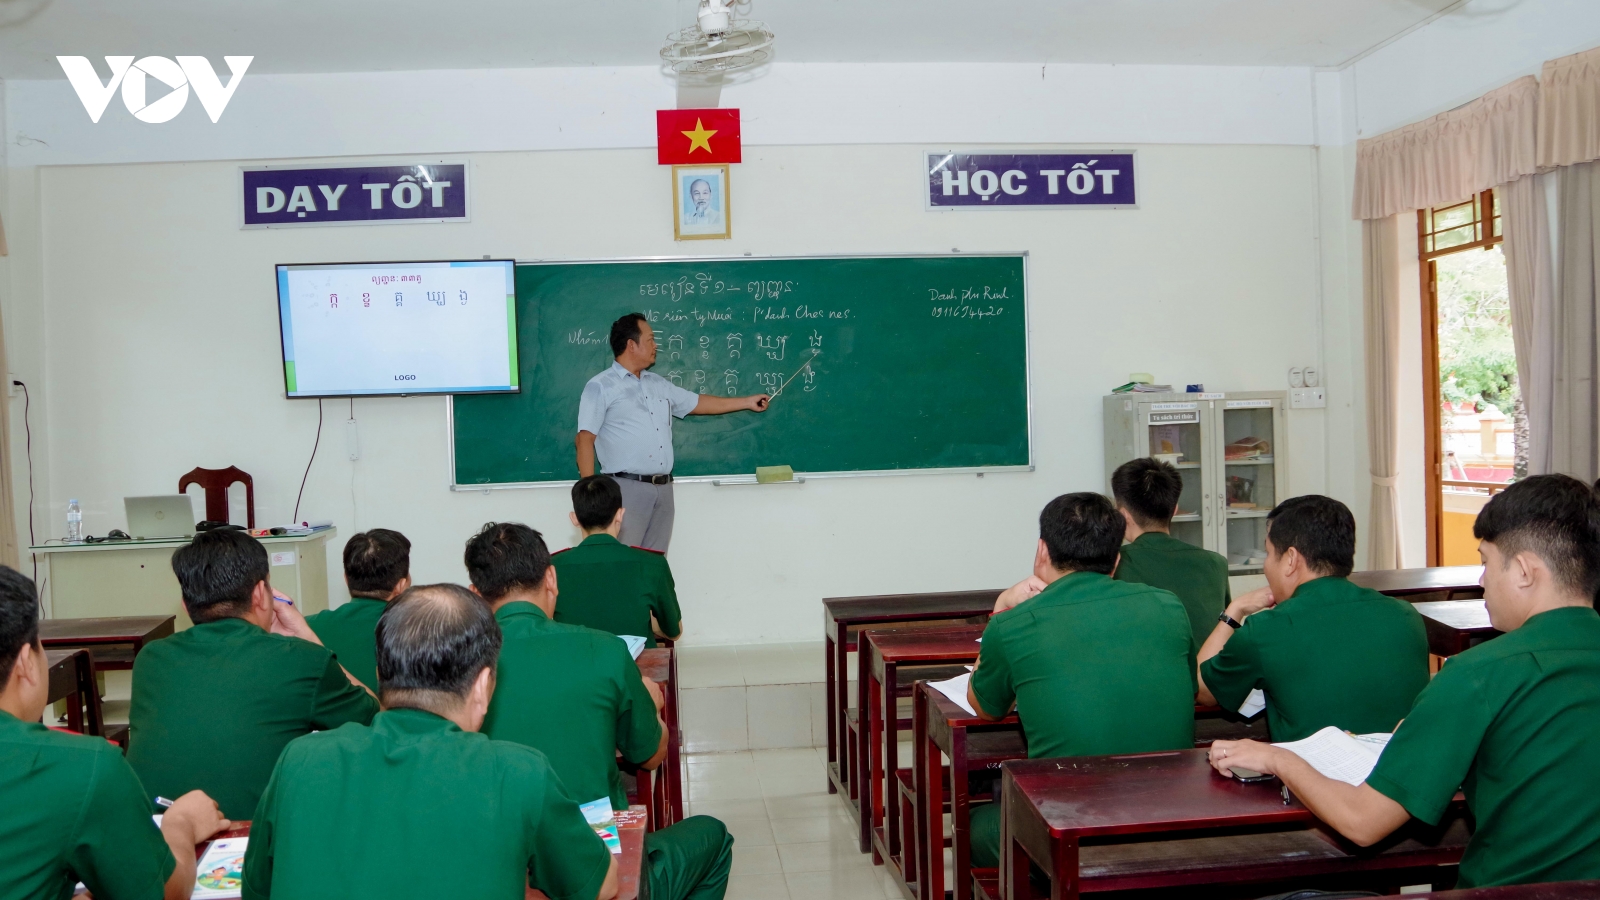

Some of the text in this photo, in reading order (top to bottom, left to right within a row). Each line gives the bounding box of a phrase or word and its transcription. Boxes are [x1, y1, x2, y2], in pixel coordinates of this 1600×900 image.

[256, 173, 452, 218] DẠY TỐT
[942, 159, 1120, 201] HỌC TỐT
